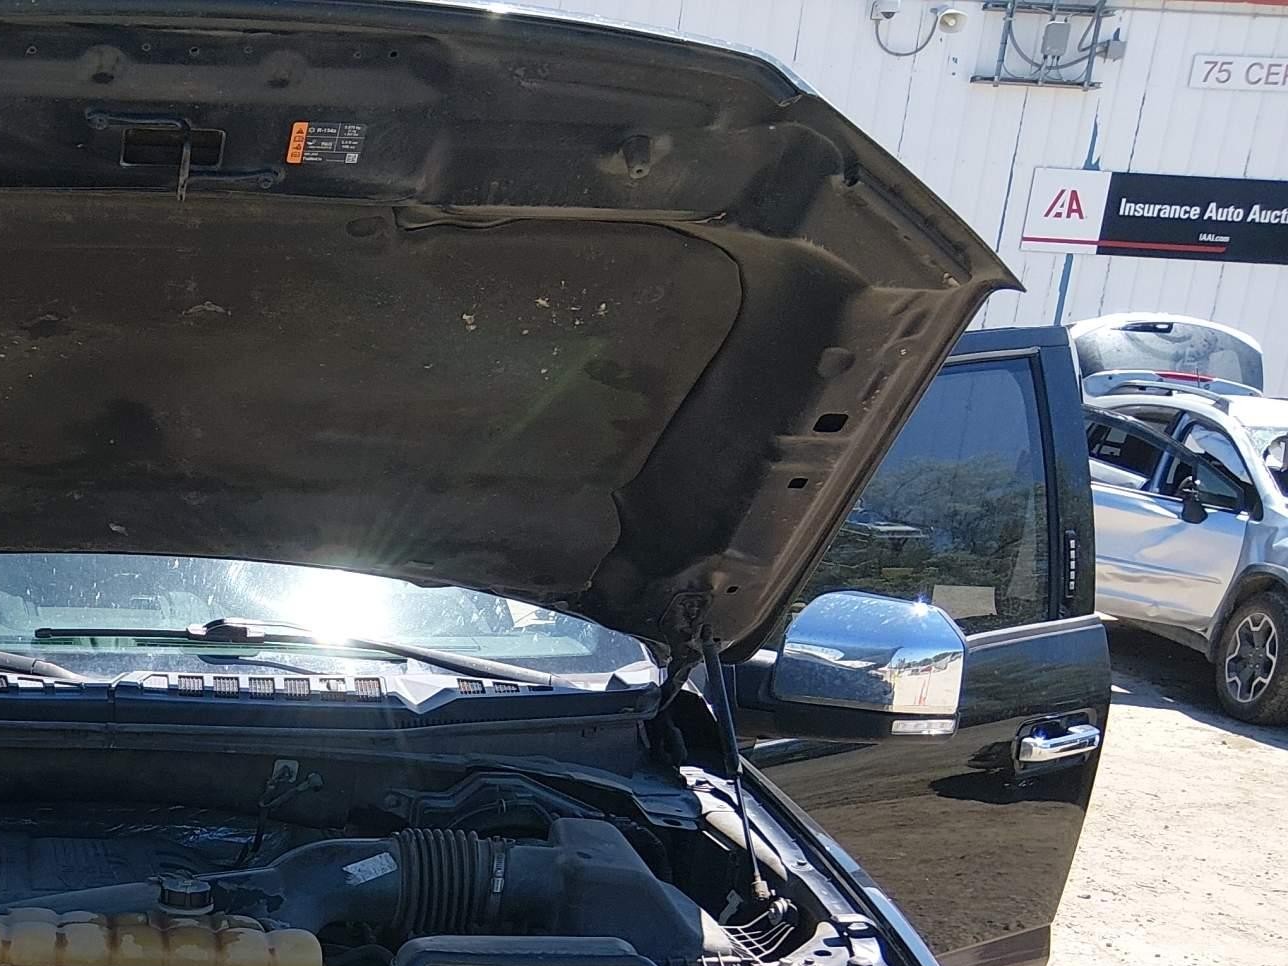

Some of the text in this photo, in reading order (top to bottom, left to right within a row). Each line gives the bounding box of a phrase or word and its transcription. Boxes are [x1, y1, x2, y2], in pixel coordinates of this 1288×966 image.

[1202, 61, 1234, 83] 75
[1119, 198, 1200, 220] Insurance
[1203, 202, 1243, 222] Auto
